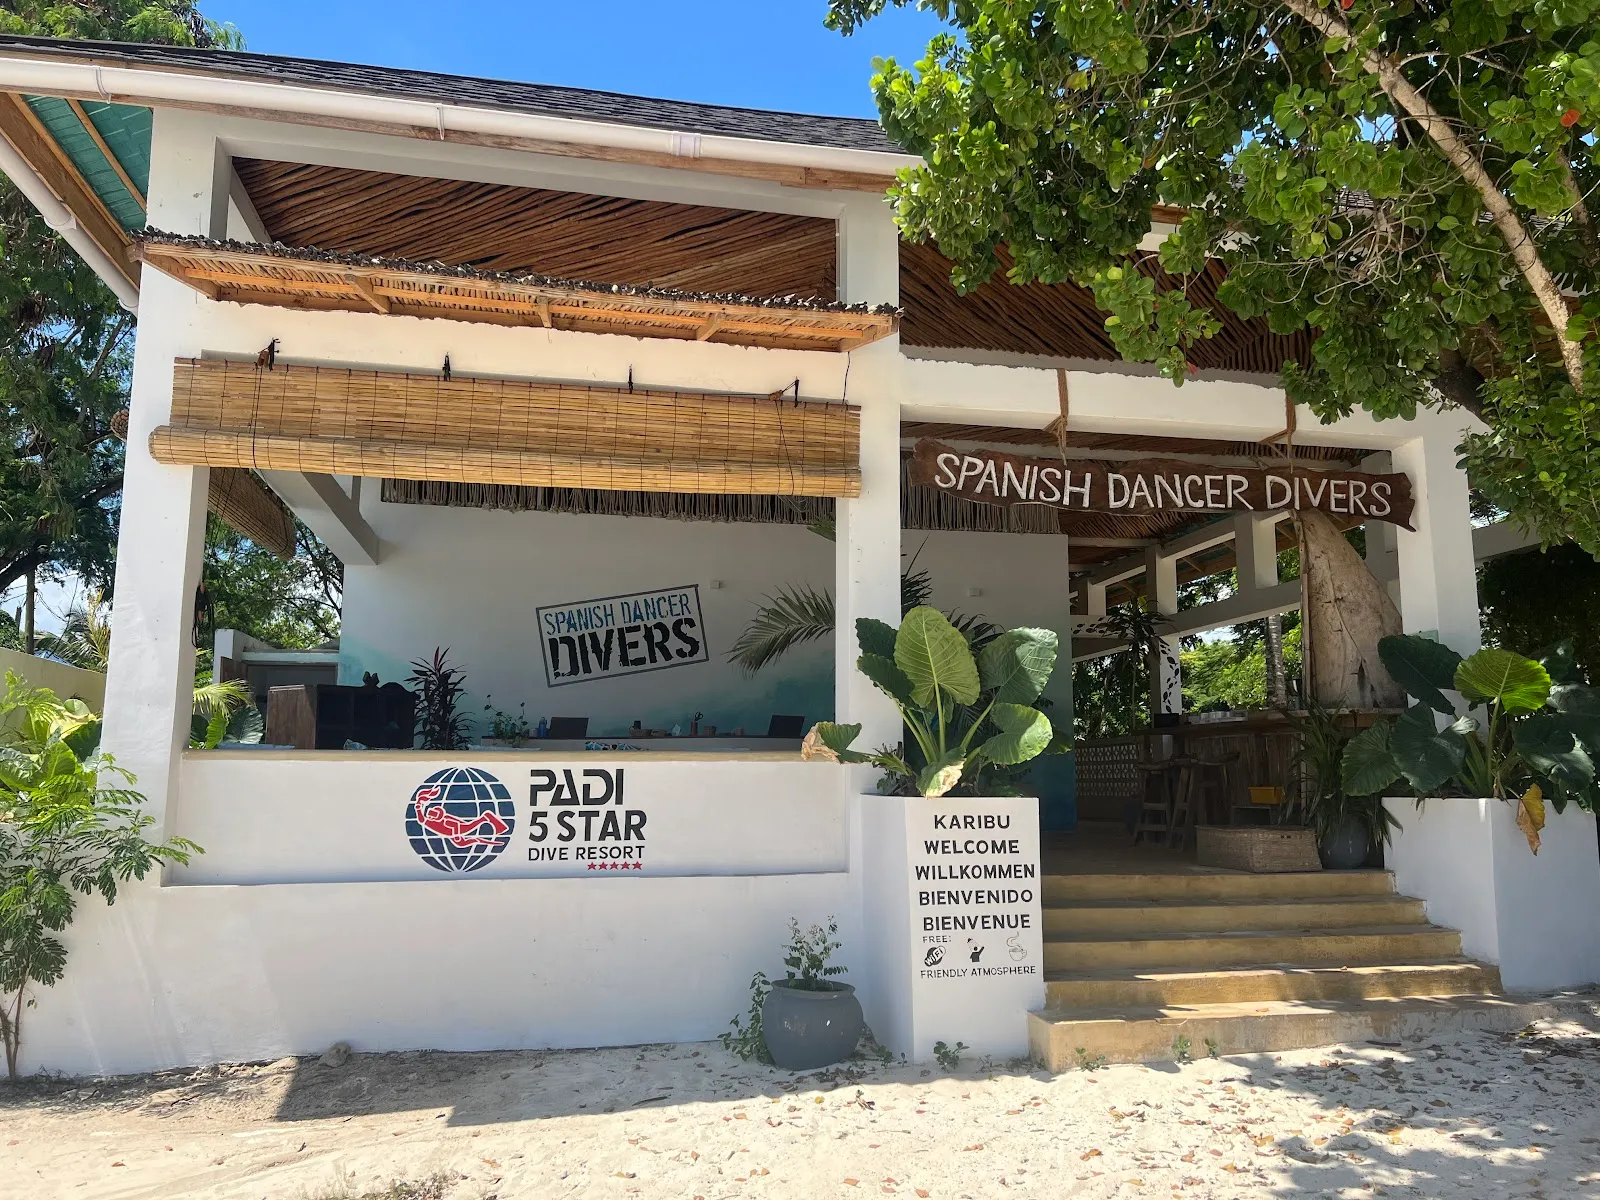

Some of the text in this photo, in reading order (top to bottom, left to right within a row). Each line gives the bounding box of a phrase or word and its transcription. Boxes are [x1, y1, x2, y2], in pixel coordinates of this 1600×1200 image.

[934, 453, 1394, 517] SPANISH DANCER DIVERS
[544, 593, 691, 636] SPANISH DANCER
[548, 617, 700, 680] DIVERS
[529, 769, 625, 806] PADI
[528, 809, 648, 842] 5 STAR
[934, 814, 1010, 829] KARIBU
[528, 845, 646, 861] DIVE RESORT
[924, 840, 1020, 855] WELCOME
[915, 864, 1035, 881] WILLKOMMEN
[919, 889, 1033, 906] BIENVENIDO
[923, 914, 1031, 931] BIENVENUE
[922, 935, 952, 944] FREE:
[920, 965, 1036, 979] FRIENDLY ATMOSPHERE
